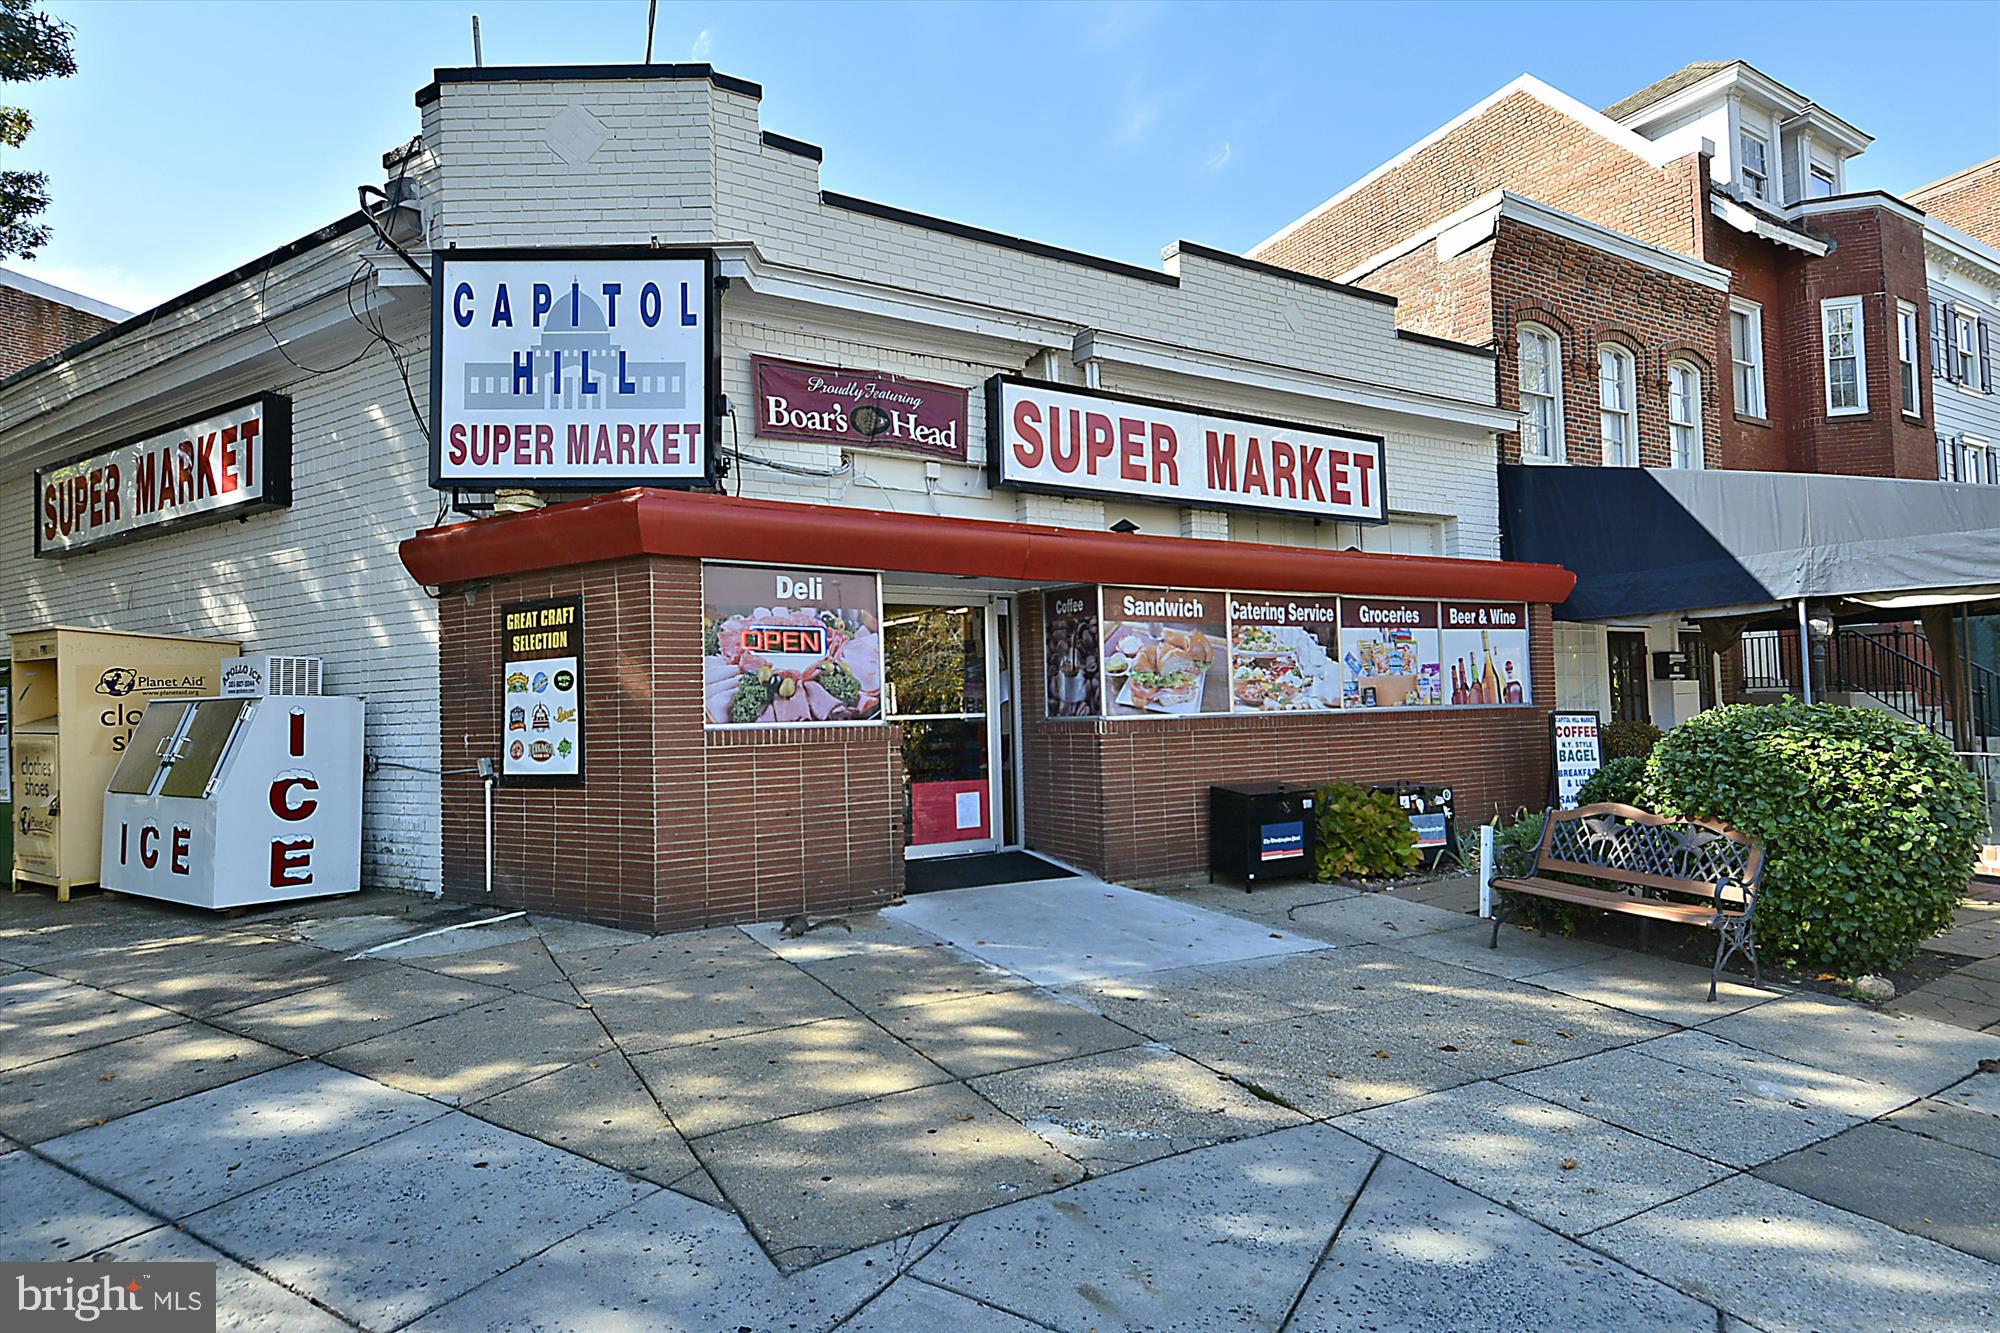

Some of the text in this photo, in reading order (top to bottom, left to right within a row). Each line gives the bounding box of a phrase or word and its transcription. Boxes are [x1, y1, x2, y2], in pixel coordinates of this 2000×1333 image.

[453, 281, 697, 328] CAPITOL
[513, 350, 635, 395] HILL
[807, 376, 924, 410] Proudly Featuring
[766, 396, 957, 449] Boar's Head
[449, 423, 701, 466] SUPER MARKET
[1012, 399, 1375, 509] SUPER MARKET
[43, 417, 260, 542] SUPER MARKET
[776, 575, 822, 600] Deli
[1056, 598, 1084, 615] Coffee
[1123, 595, 1204, 618] Sandwich
[1231, 600, 1334, 625] Catering Service
[1359, 605, 1420, 624] Groceries
[1450, 608, 1517, 625] Beer & Wine
[506, 606, 575, 631] GREAT CRAFT
[512, 630, 568, 653] SELECTION
[742, 629, 820, 652] OPEN
[138, 676, 203, 687] Planet Aid
[222, 664, 262, 687] APOLLO ICE
[1556, 725, 1597, 738] COFFEE
[21, 755, 52, 776] clothes
[1559, 749, 1597, 763] BAGEL
[1556, 768, 1597, 778] BREAKFAS
[25, 777, 50, 797] shoes
[119, 815, 192, 876] ICE
